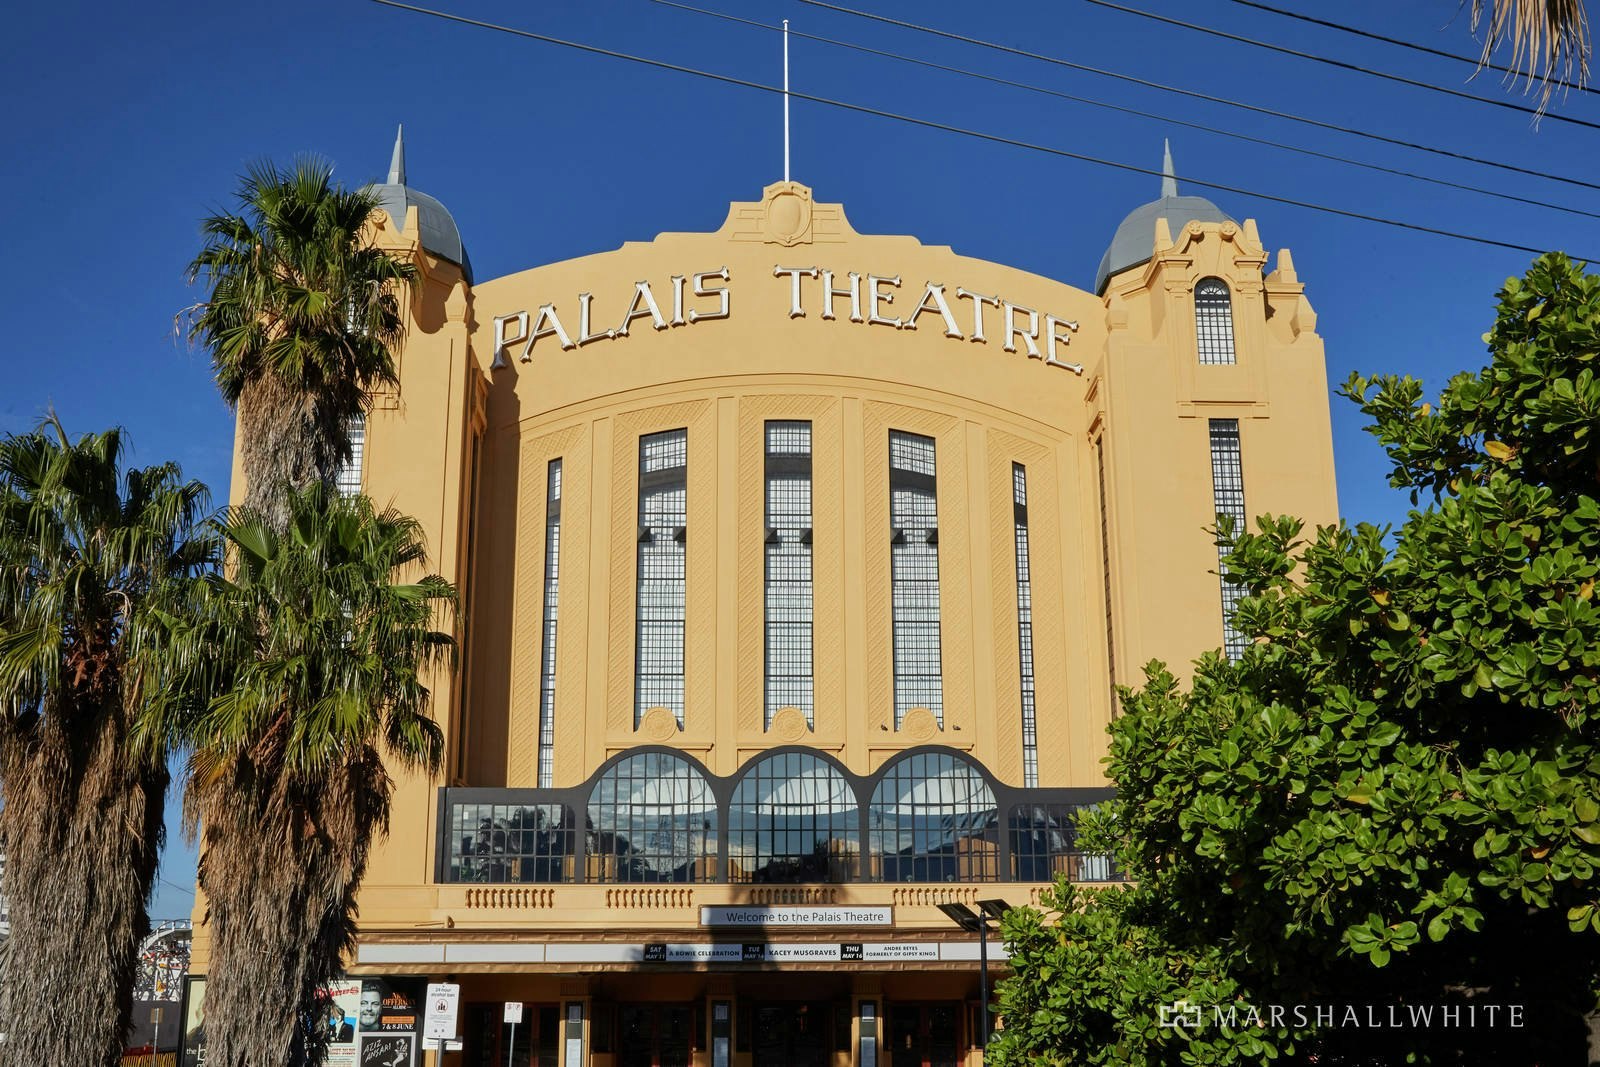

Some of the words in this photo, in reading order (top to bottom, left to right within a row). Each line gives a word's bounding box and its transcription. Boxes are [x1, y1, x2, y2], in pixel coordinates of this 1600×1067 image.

[490, 265, 731, 370] PALAIS
[773, 264, 1083, 376] THEATRE
[726, 911, 775, 922] Welcome
[778, 913, 789, 922] to
[792, 911, 809, 922] the
[812, 911, 841, 922] Palais
[844, 911, 884, 922] Theatre
[186, 1047, 197, 1055] the
[363, 1039, 382, 1056] AZIZ
[365, 1043, 392, 1064] ANSARI
